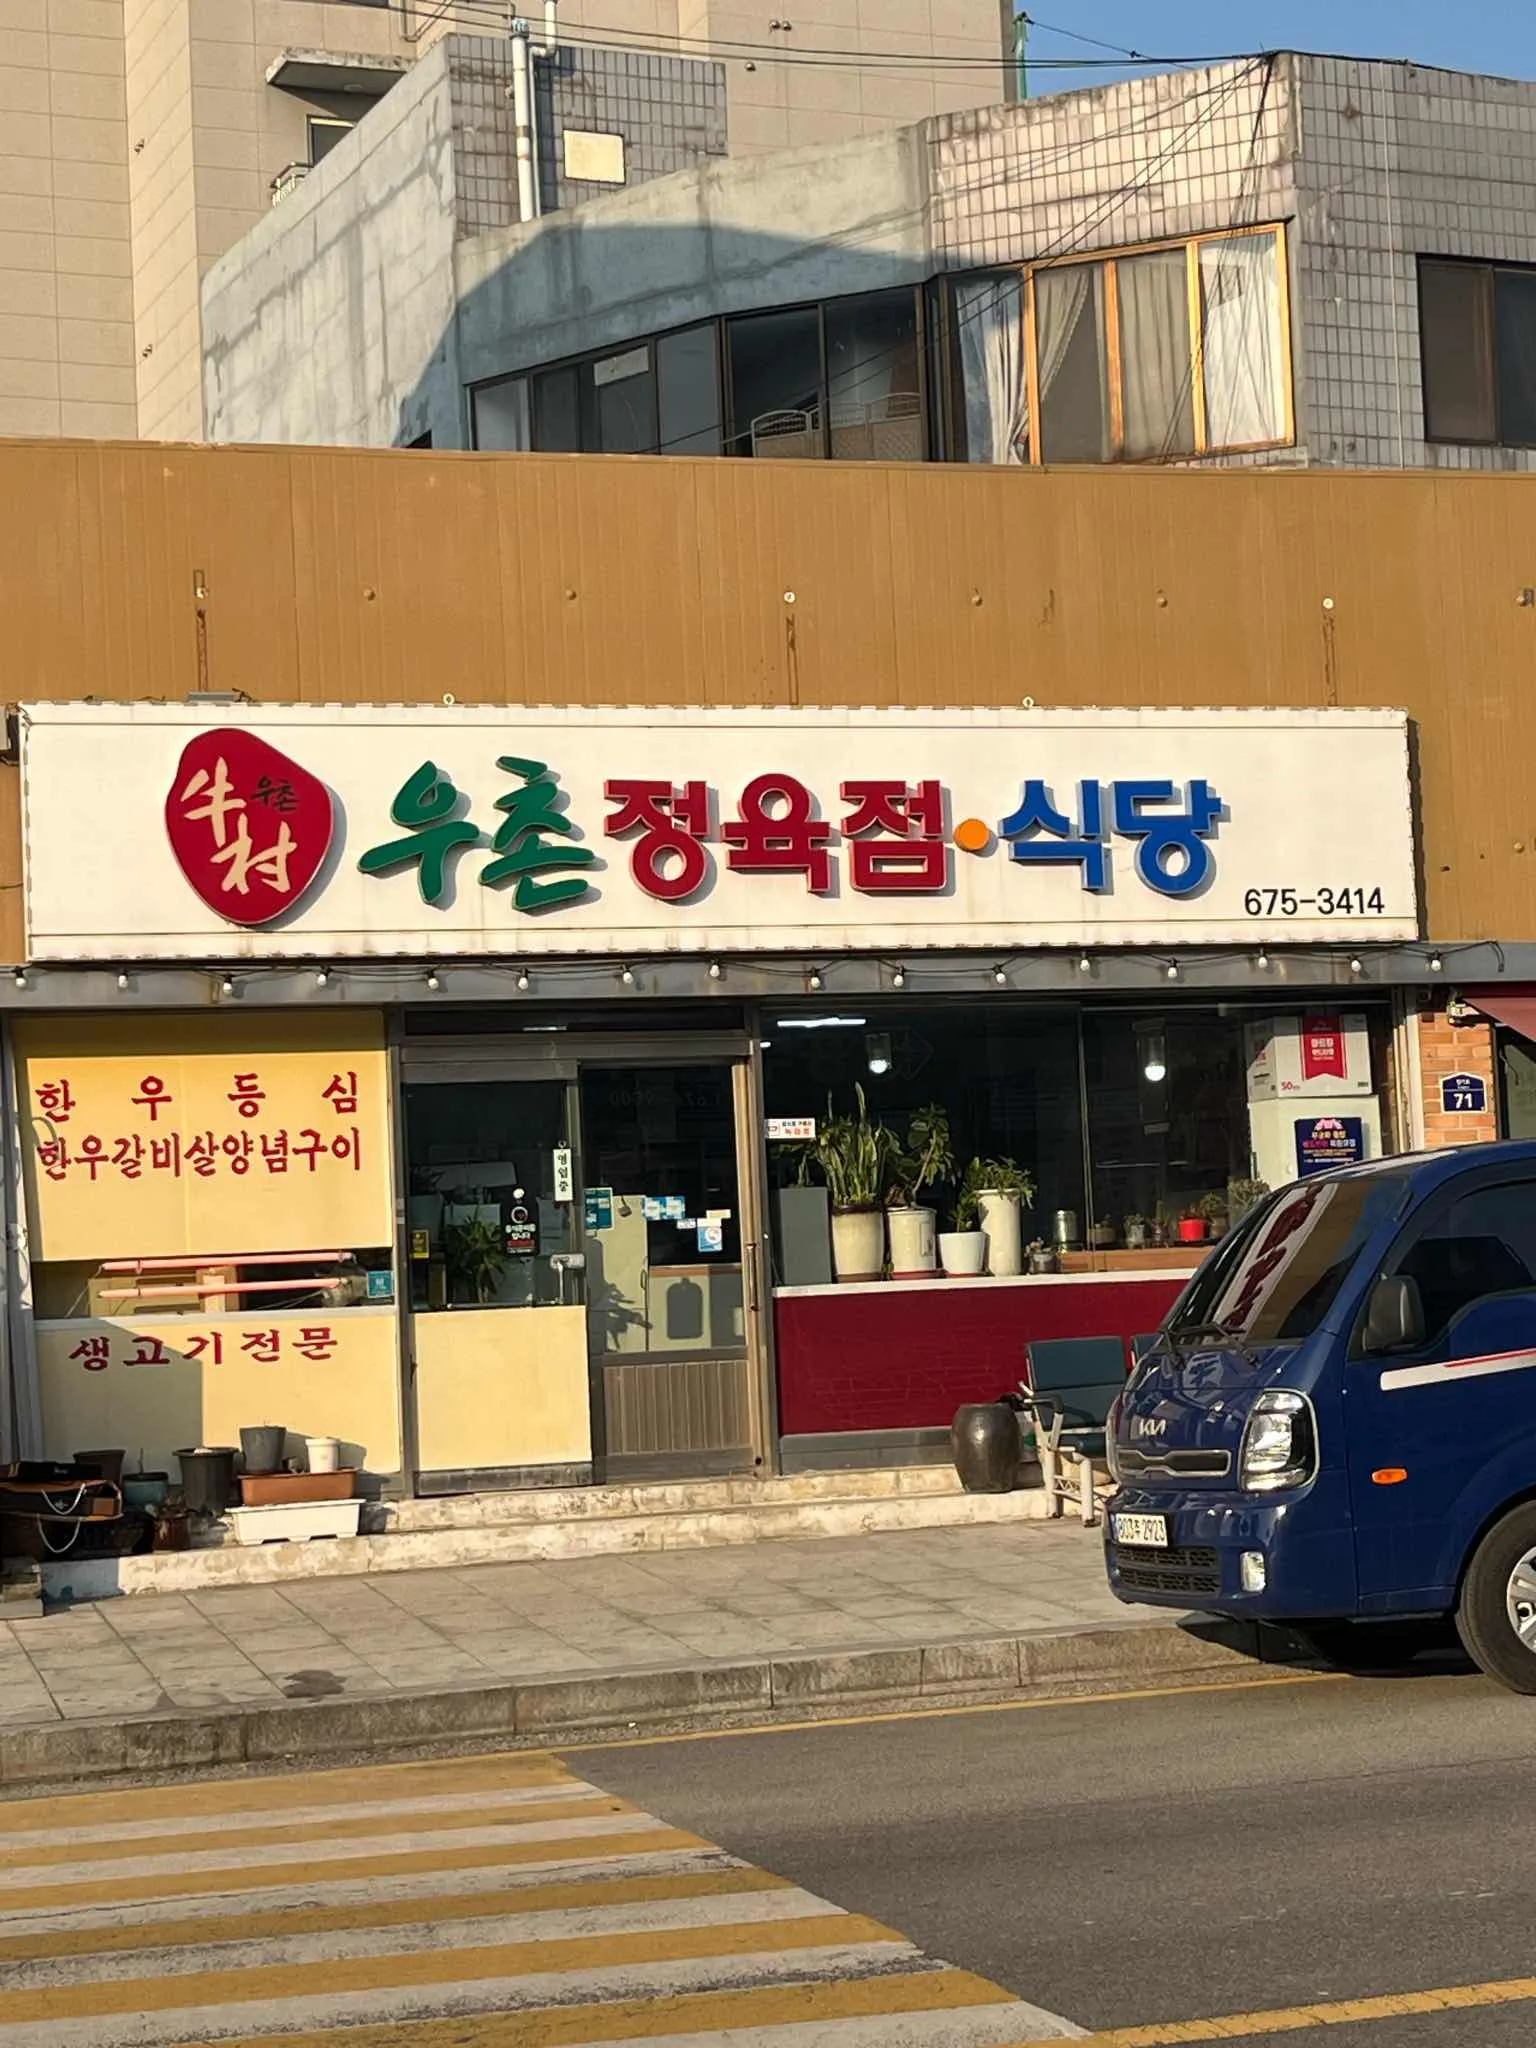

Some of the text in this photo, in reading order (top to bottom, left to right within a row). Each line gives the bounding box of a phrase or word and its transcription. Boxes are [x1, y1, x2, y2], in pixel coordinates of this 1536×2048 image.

[251, 775, 299, 811] 우촌
[358, 755, 596, 910] 우촌
[1244, 887, 1385, 916] 675-3414
[1453, 1093, 1473, 1109] 71
[36, 1126, 362, 1181] 한우갈비살양념구이
[557, 1152, 569, 1192] 영업중
